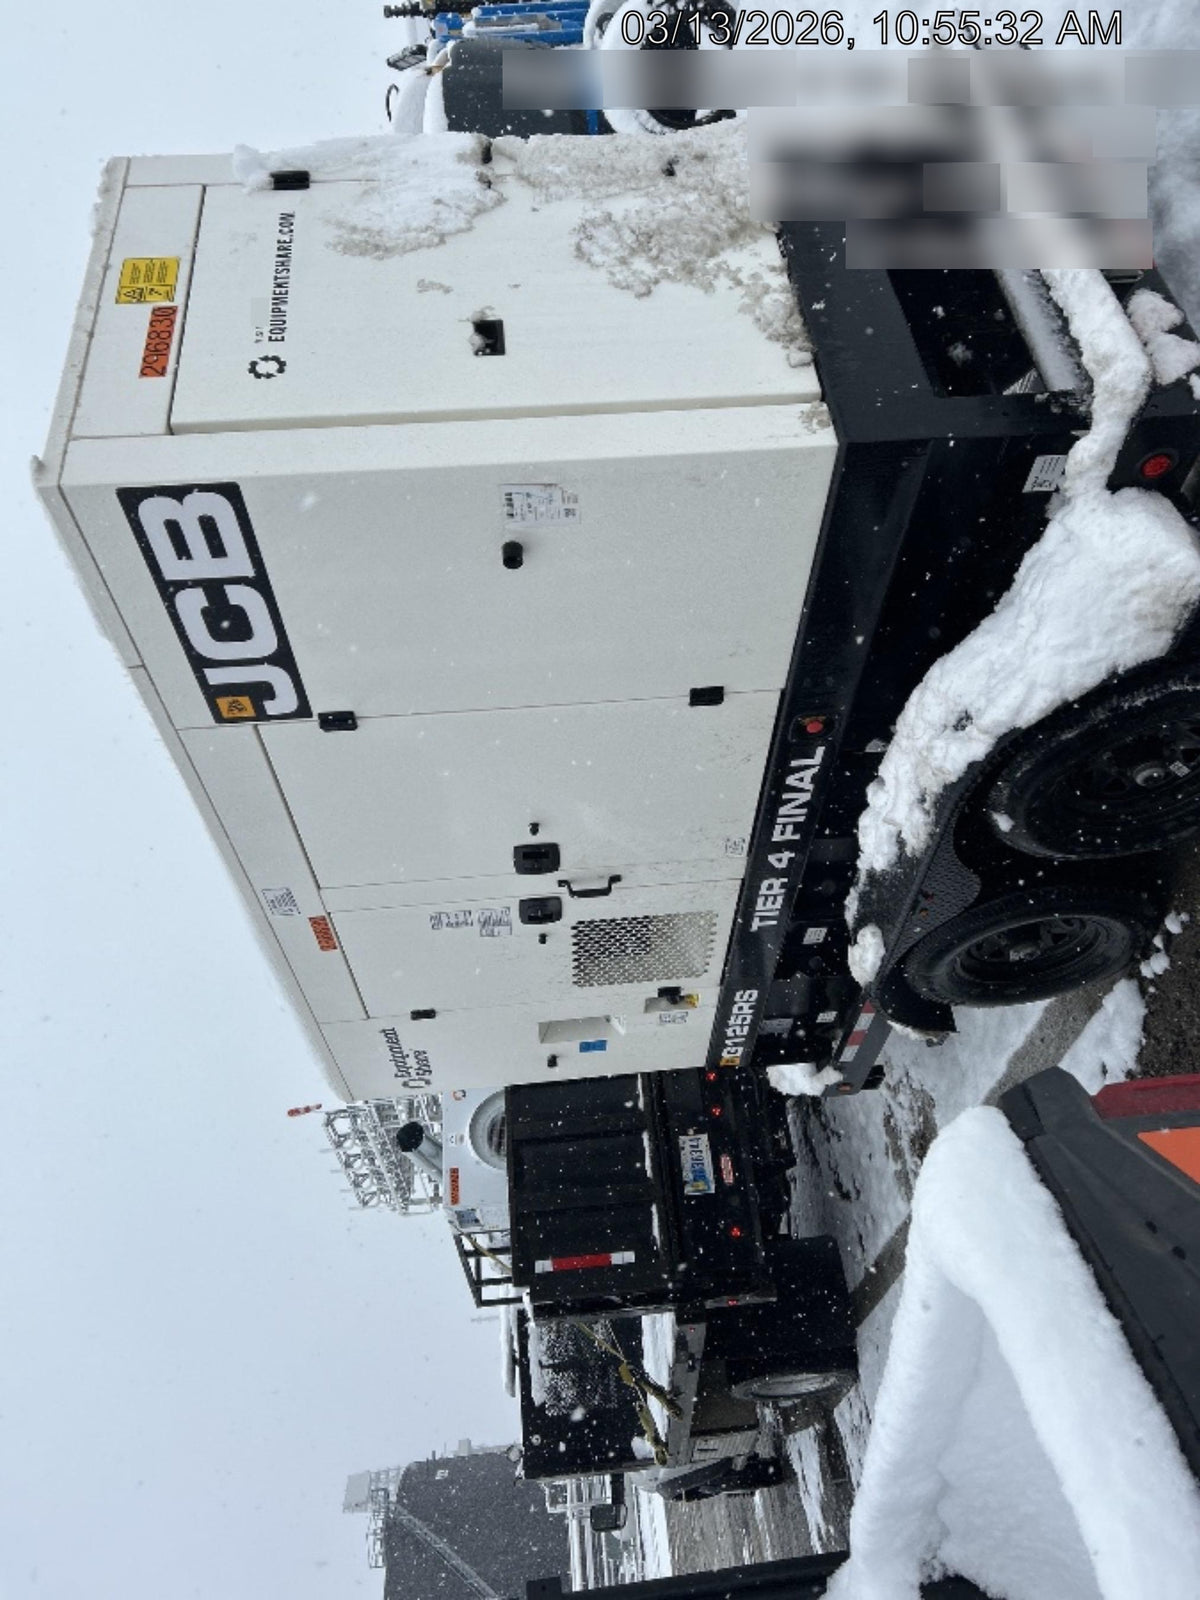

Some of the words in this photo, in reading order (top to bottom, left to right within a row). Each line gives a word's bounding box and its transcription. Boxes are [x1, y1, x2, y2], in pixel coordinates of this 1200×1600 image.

[268, 211, 295, 342] EQUIPMENTSHARE.COM
[140, 306, 176, 378] 296830
[137, 491, 299, 716] JCB
[771, 746, 826, 842] FINAL
[767, 851, 796, 869] 4
[750, 877, 789, 932] TIER
[379, 1027, 413, 1078] Equipment
[722, 989, 759, 1057] G125RS
[413, 1050, 433, 1076] Share
